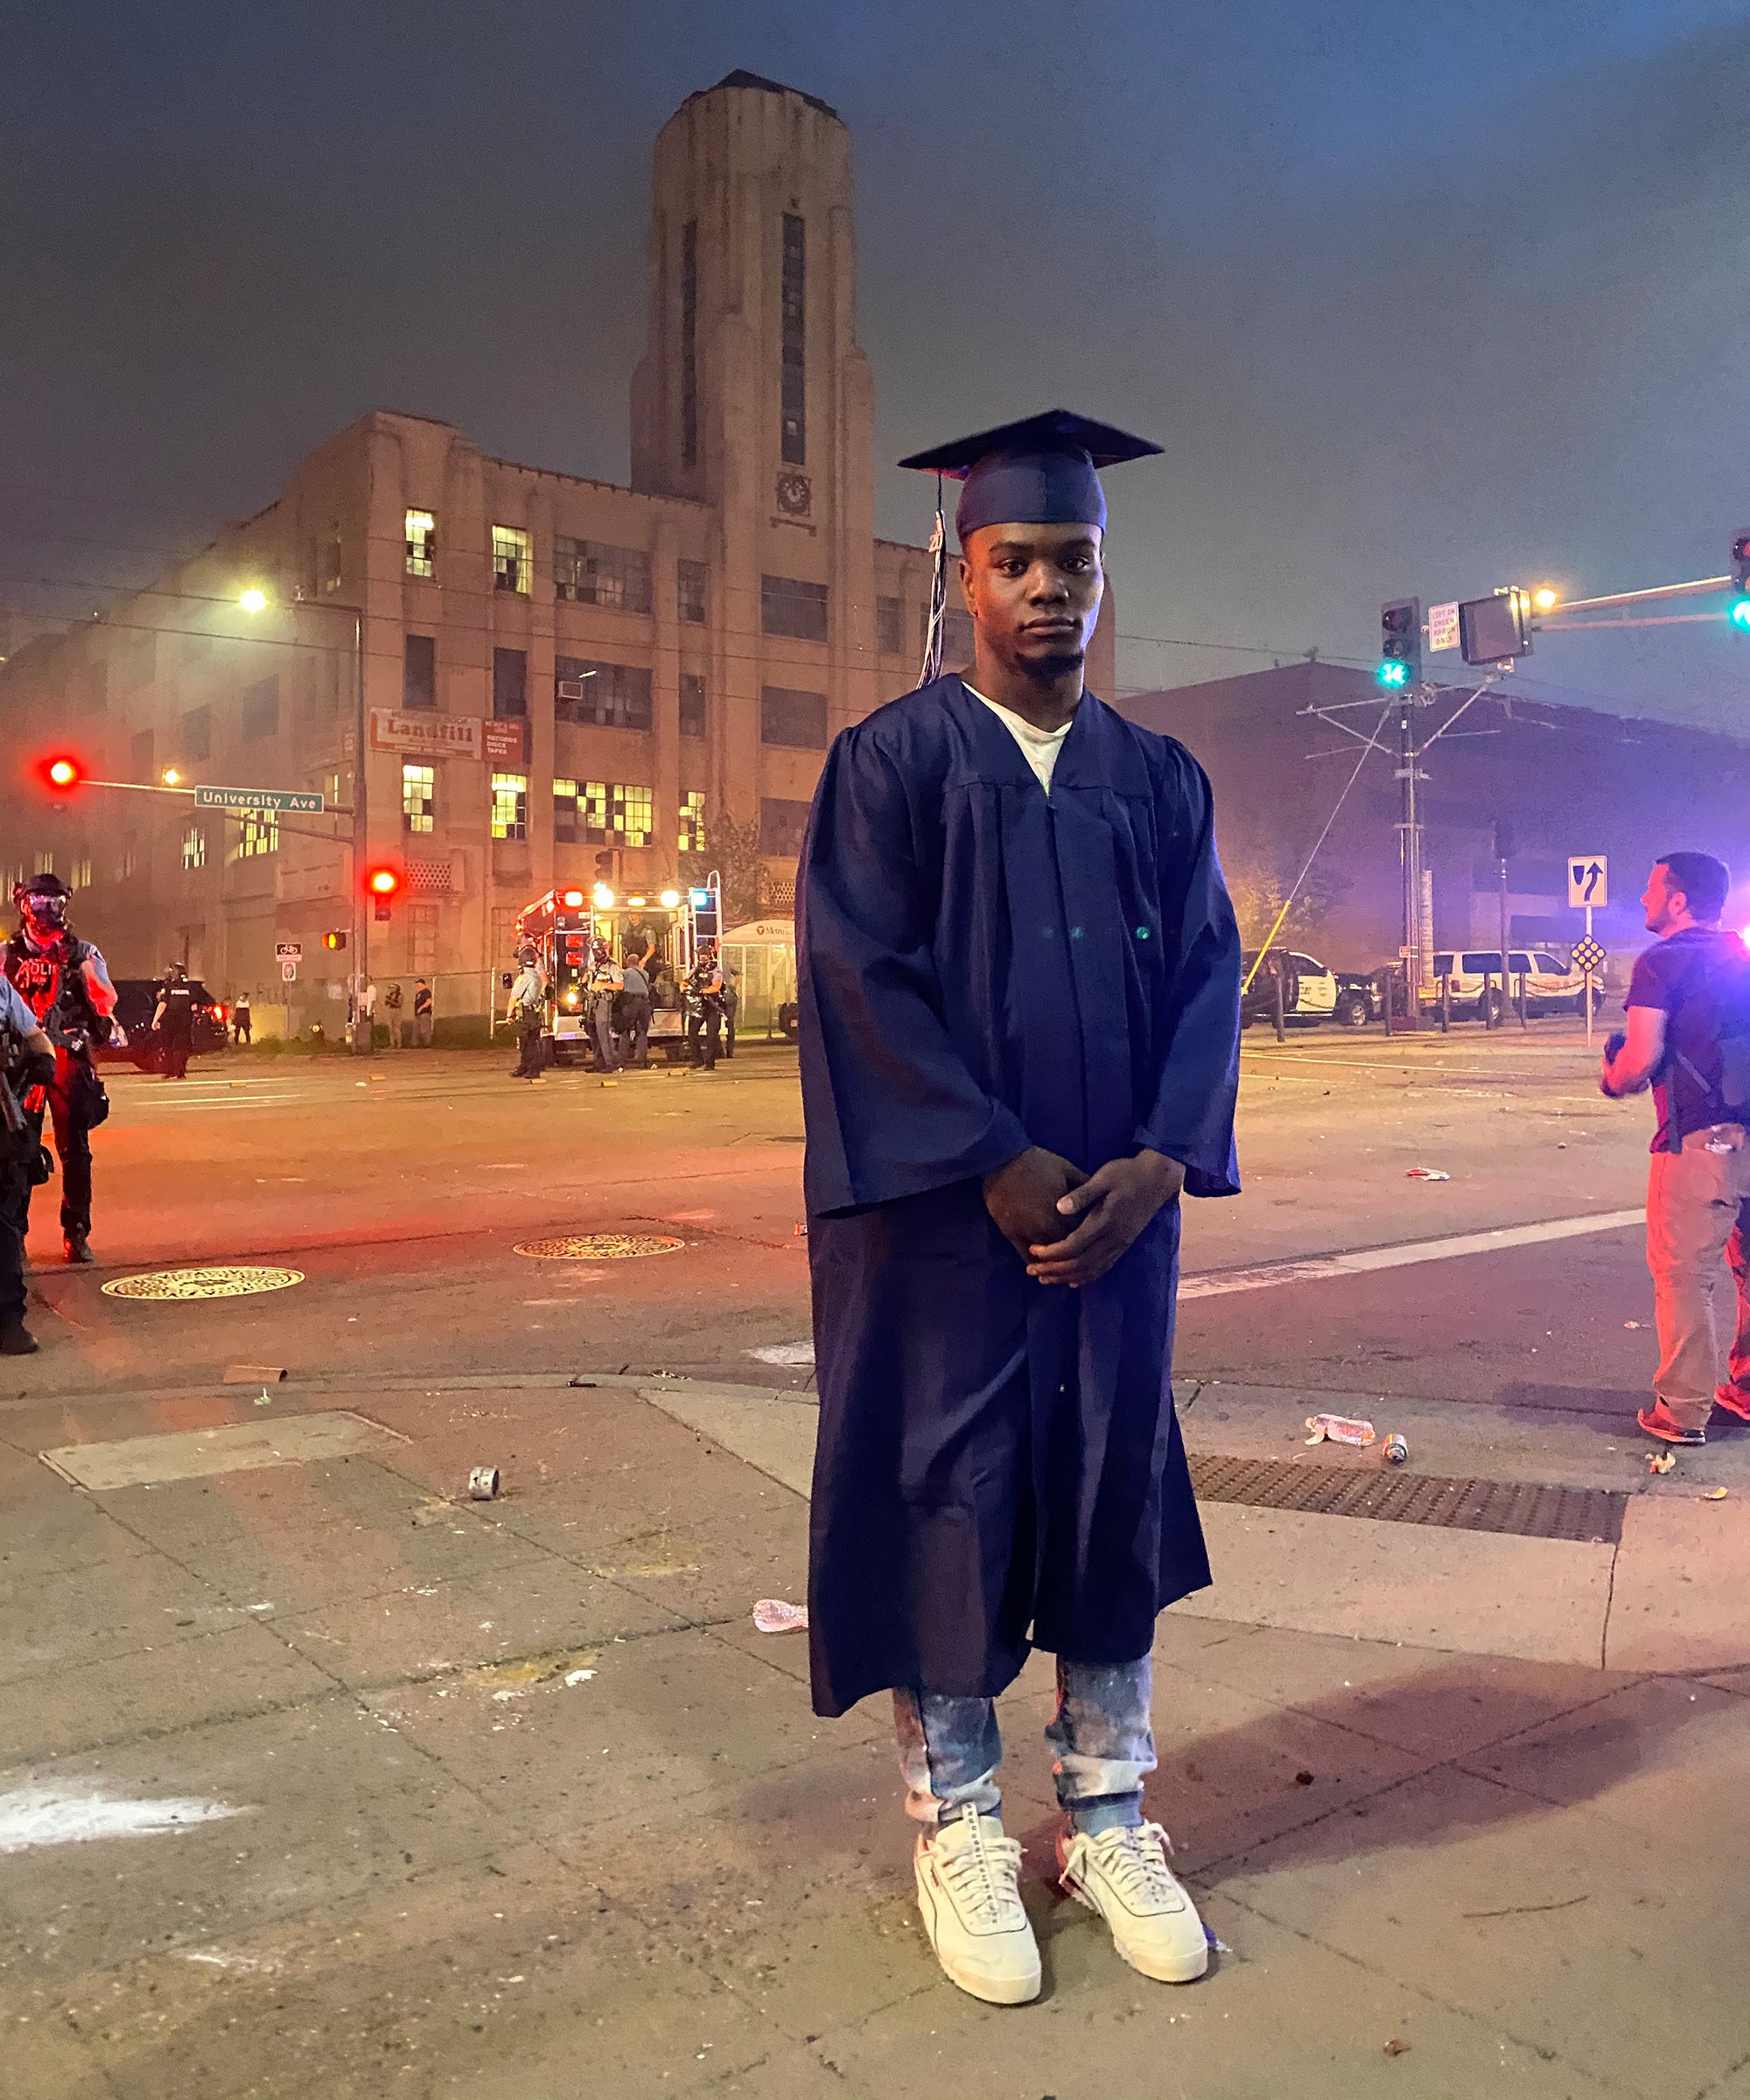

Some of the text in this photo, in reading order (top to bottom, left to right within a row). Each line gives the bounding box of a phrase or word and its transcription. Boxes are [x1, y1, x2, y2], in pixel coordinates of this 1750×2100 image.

[1433, 617, 1454, 627] GREEN
[1433, 626, 1456, 636] ARROW
[1435, 636, 1452, 645] ONLY
[388, 719, 472, 742] Landfill
[486, 735, 517, 744] RECORDS
[203, 791, 316, 808] University Ave
